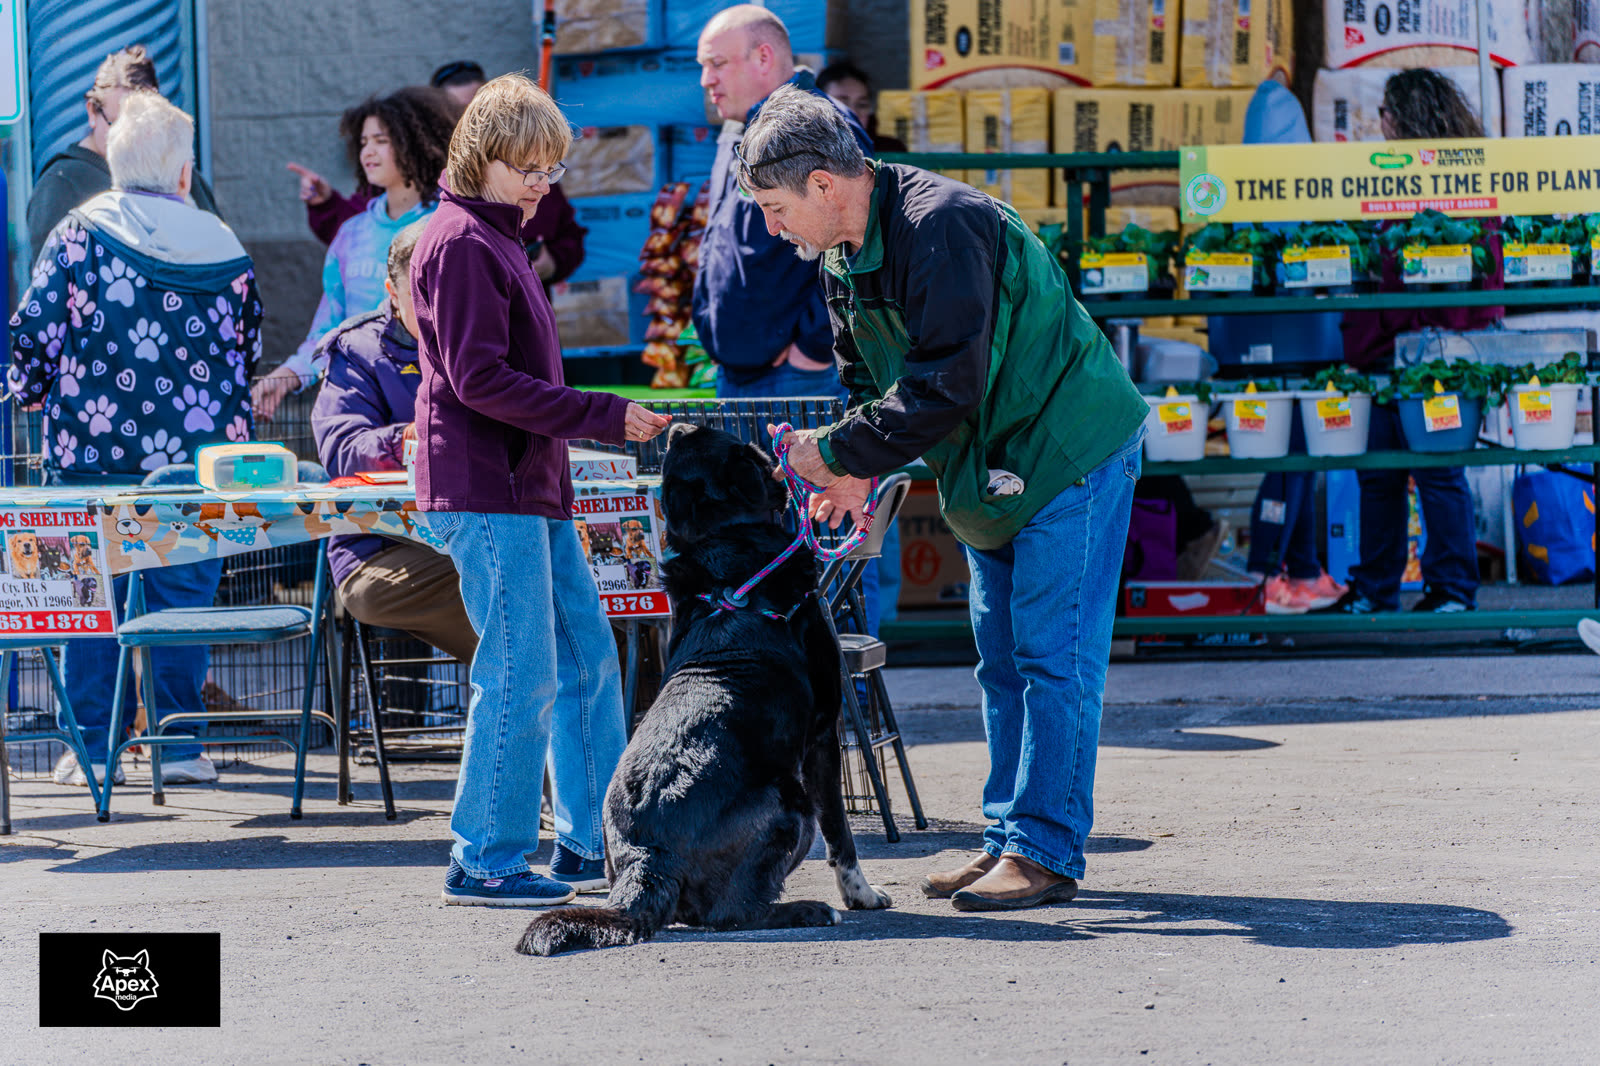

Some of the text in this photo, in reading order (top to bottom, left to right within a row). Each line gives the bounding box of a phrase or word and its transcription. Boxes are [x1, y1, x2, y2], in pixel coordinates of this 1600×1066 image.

[1438, 158, 1472, 167] SUPPLY
[1235, 178, 1287, 200] TIME
[1295, 178, 1334, 199] FOR
[1341, 175, 1423, 198] CHICKS
[1430, 173, 1482, 195] TIME
[1490, 171, 1529, 193] FOR
[1368, 199, 1490, 212] BUILD YOUR PERFECT GARDEN
[572, 495, 649, 515] SHELTER
[20, 511, 97, 526] SHELTER
[2, 581, 20, 596] Cty.
[22, 581, 38, 593] Rt.
[597, 579, 627, 591] 12966
[26, 596, 40, 608] NY
[43, 595, 73, 607] 12966
[0, 613, 99, 630] 651-1376
